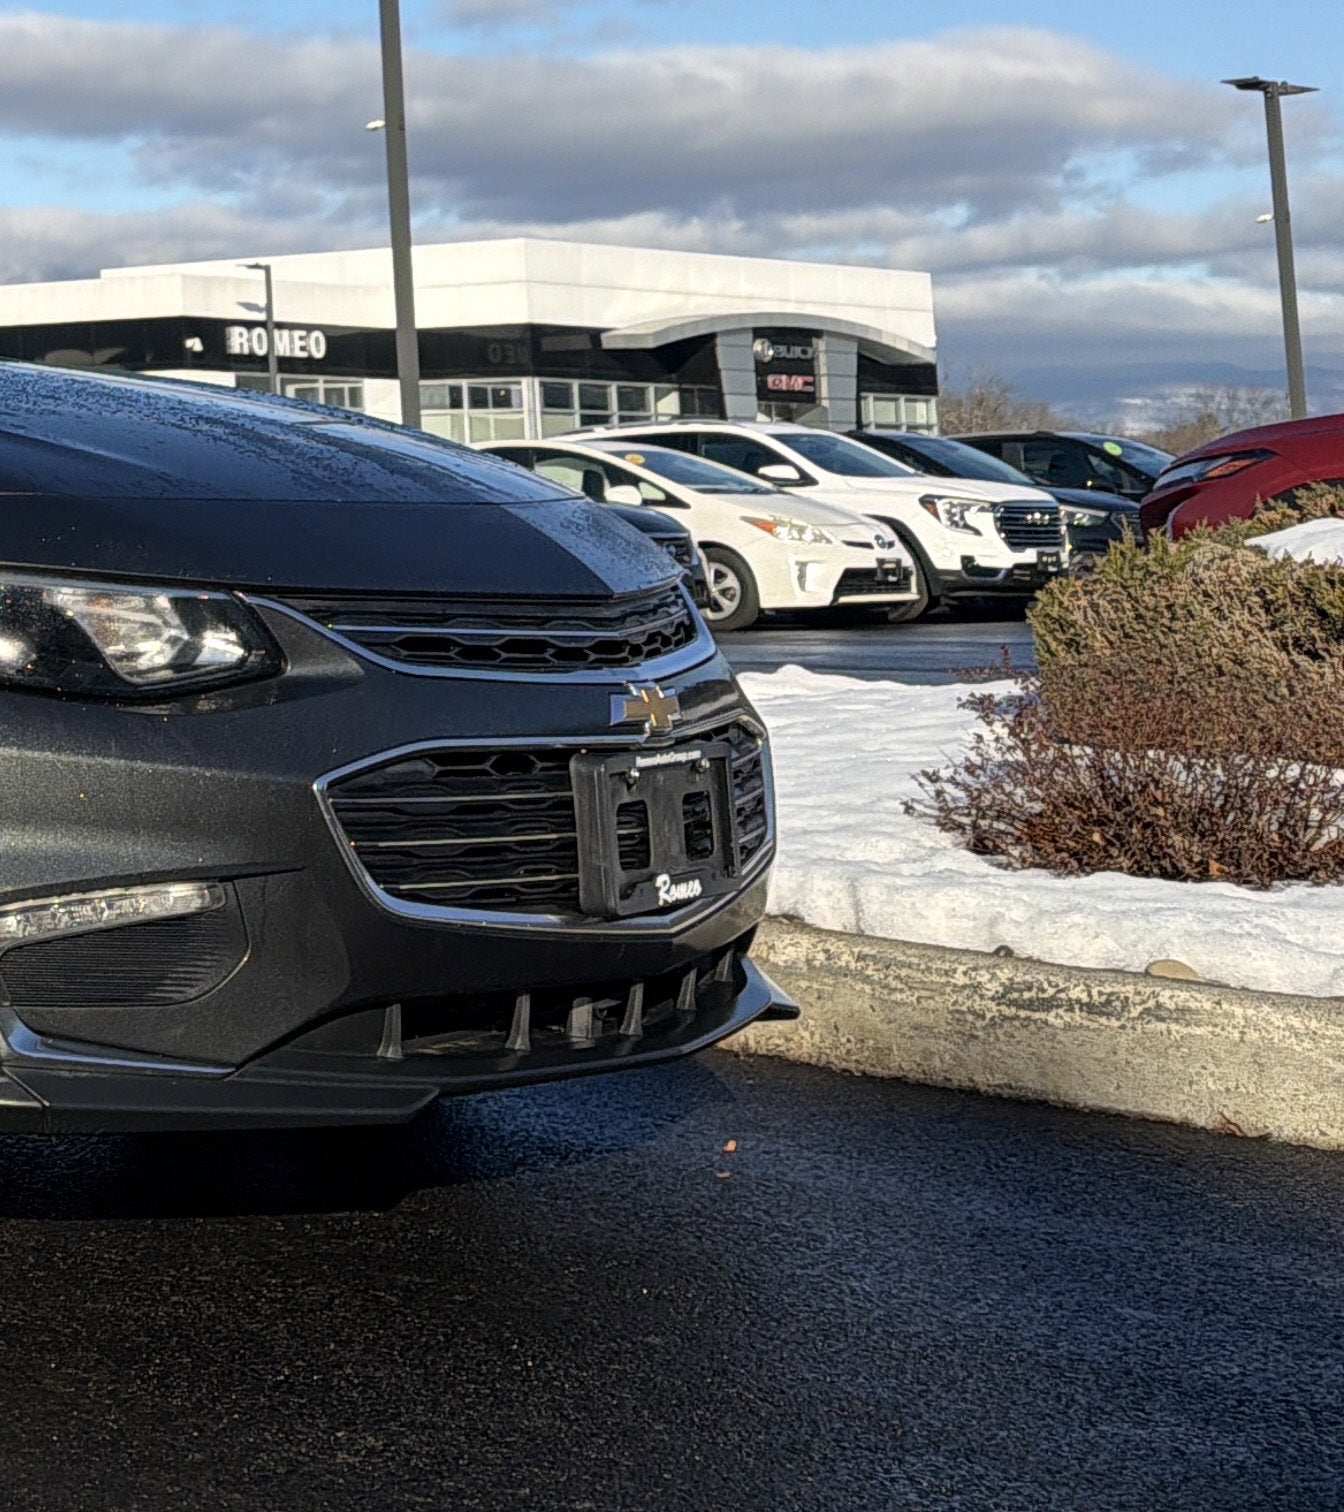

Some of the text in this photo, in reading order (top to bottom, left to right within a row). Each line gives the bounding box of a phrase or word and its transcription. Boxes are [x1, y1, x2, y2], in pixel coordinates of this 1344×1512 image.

[226, 326, 327, 359] ROMEO
[767, 374, 815, 392] GMC
[655, 873, 702, 906] Romeo
